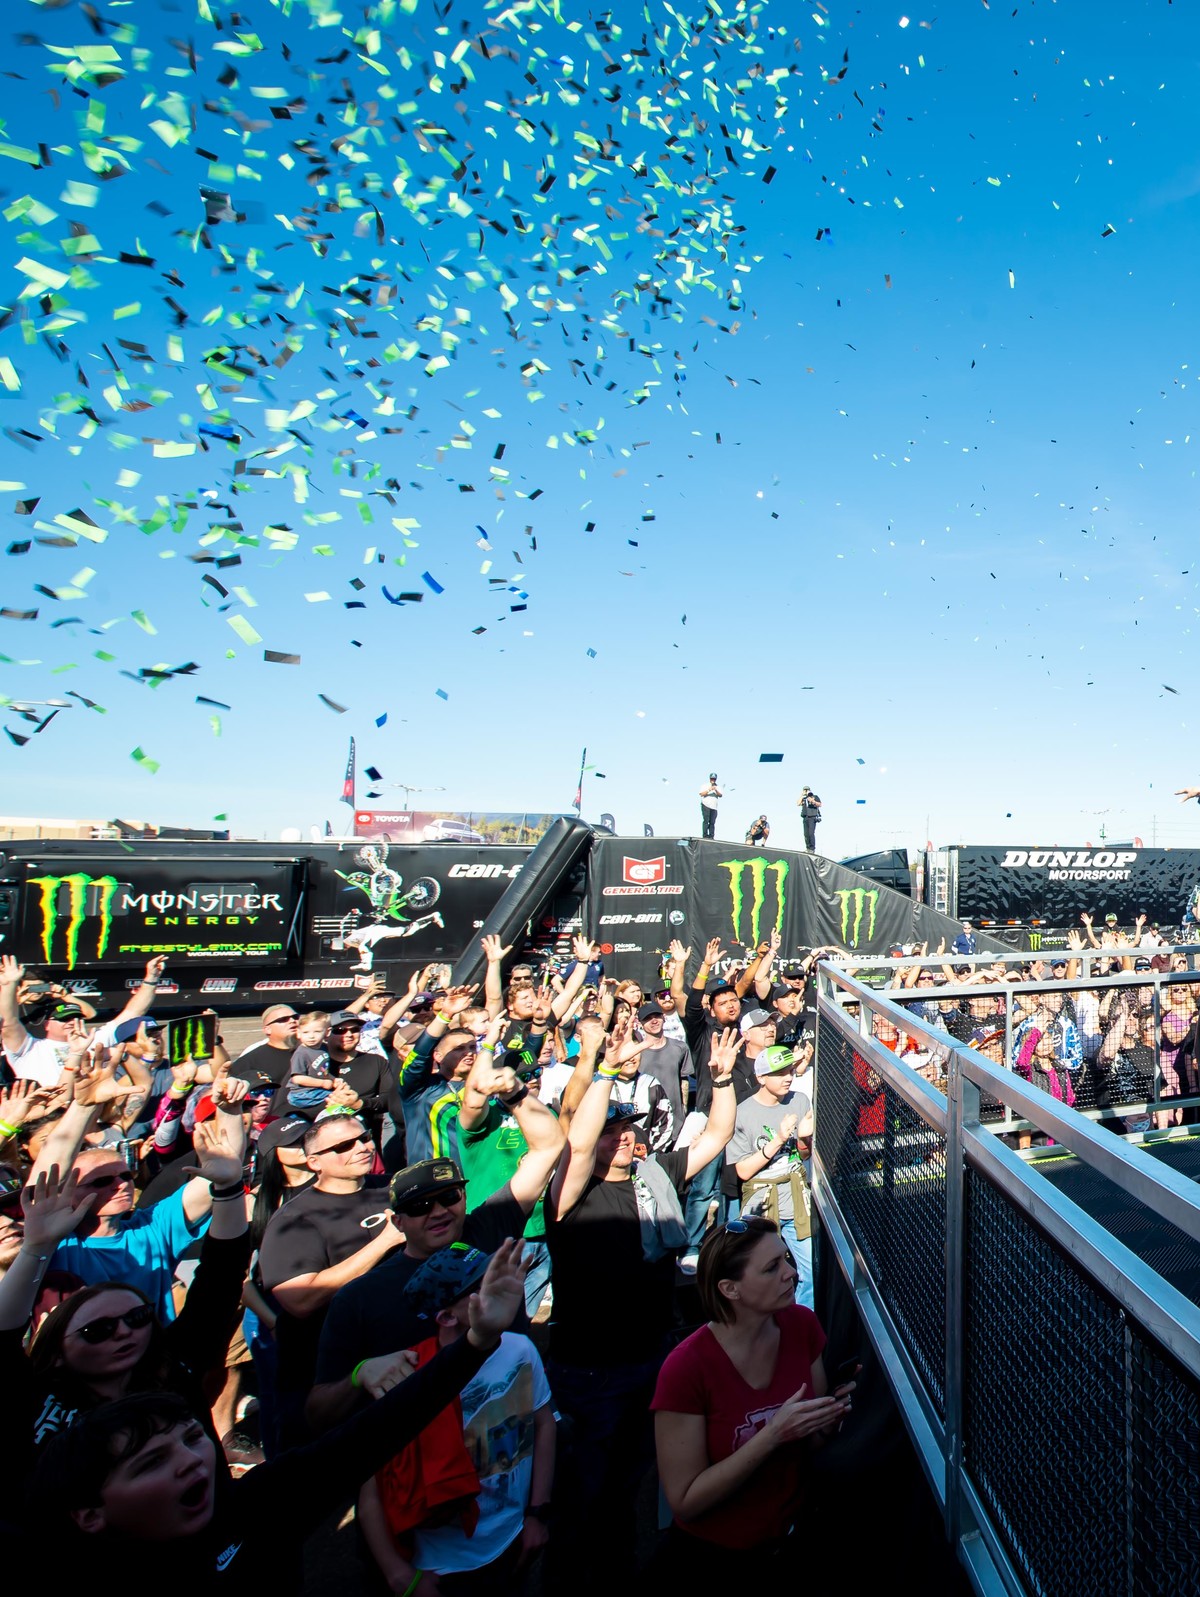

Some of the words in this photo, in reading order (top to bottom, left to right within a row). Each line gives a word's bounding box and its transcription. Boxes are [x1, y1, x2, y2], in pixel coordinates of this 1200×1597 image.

[374, 815, 410, 823] TOYOTA
[1000, 850, 1138, 868] DUNLOP
[448, 863, 525, 878] can-a
[629, 864, 661, 880] GT
[1048, 869, 1132, 880] MOTORSPORT
[604, 886, 654, 894] GENERAL
[657, 886, 683, 894] TIRE
[121, 890, 284, 914] MONSTER
[144, 916, 260, 925] ENERGY
[62, 978, 99, 993] FOX
[255, 980, 319, 989] GENERAL
[320, 979, 352, 988] TIRE
[216, 1543, 236, 1564] NIKE
